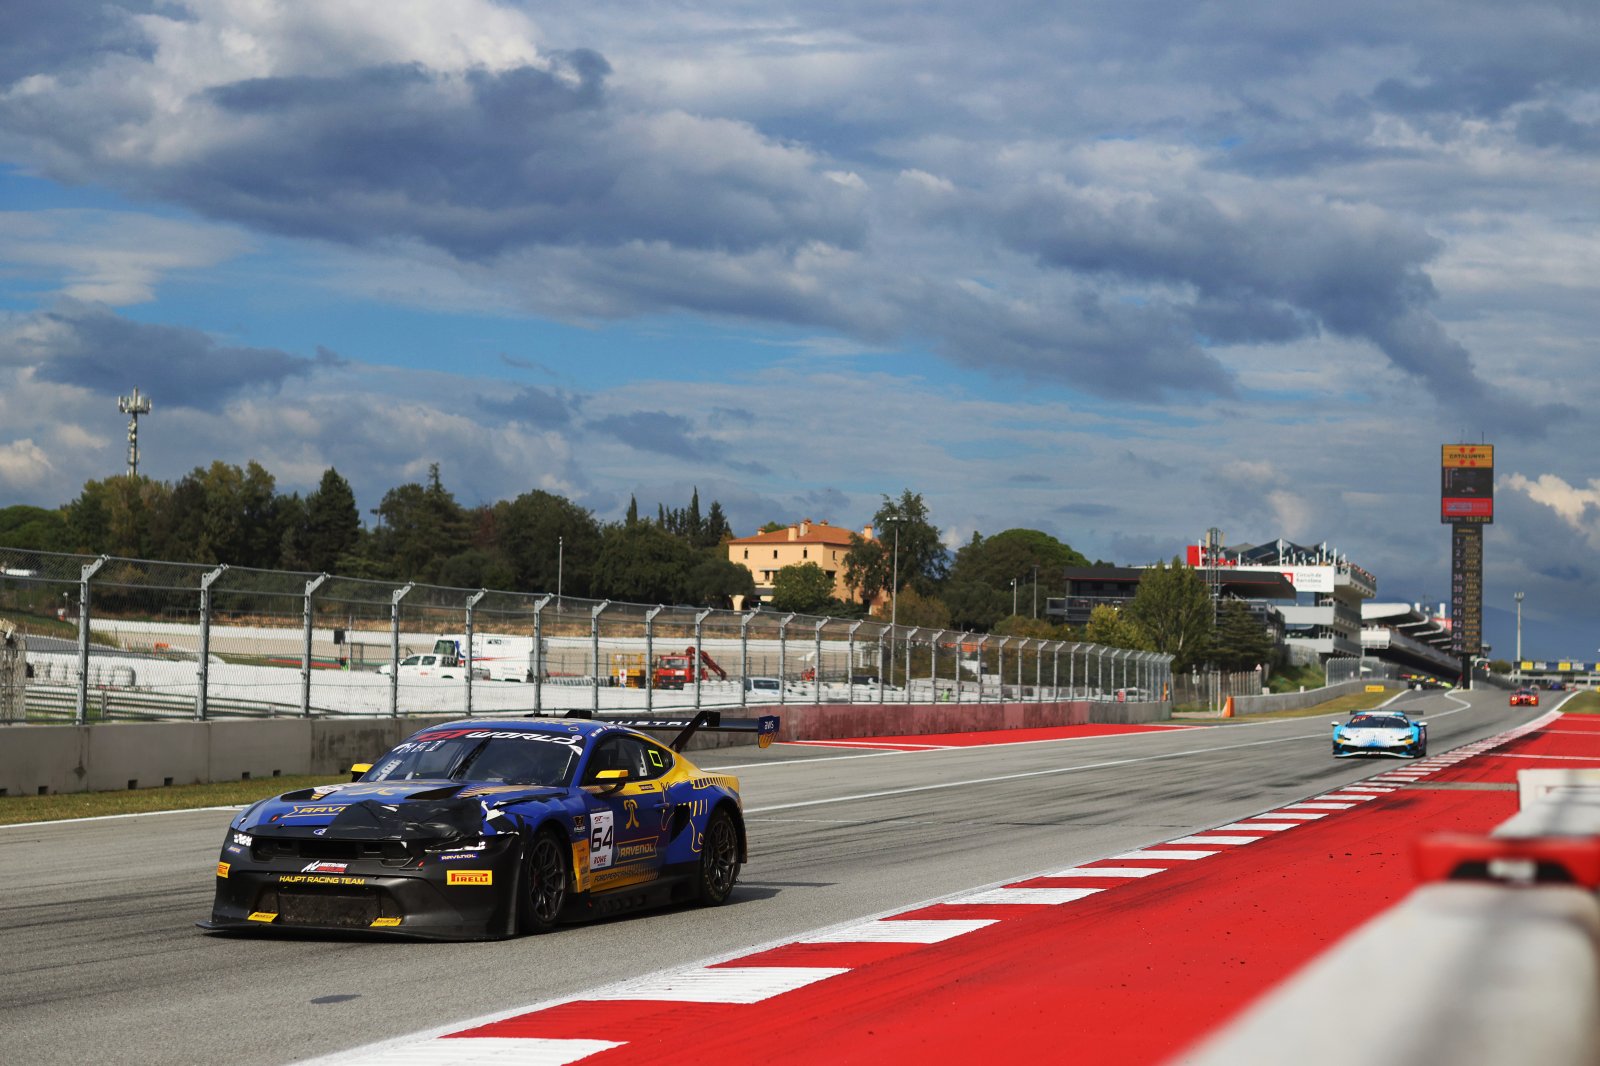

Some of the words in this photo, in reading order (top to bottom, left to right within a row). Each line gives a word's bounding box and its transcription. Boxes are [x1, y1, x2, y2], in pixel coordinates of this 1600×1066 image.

[466, 731, 576, 745] WORLD
[591, 825, 613, 853] 64
[620, 843, 655, 857] RAVENOL
[279, 875, 306, 883] HAUPT
[307, 876, 340, 884] RACING
[341, 877, 365, 885] TEAM
[451, 873, 488, 883] PIRELLI
